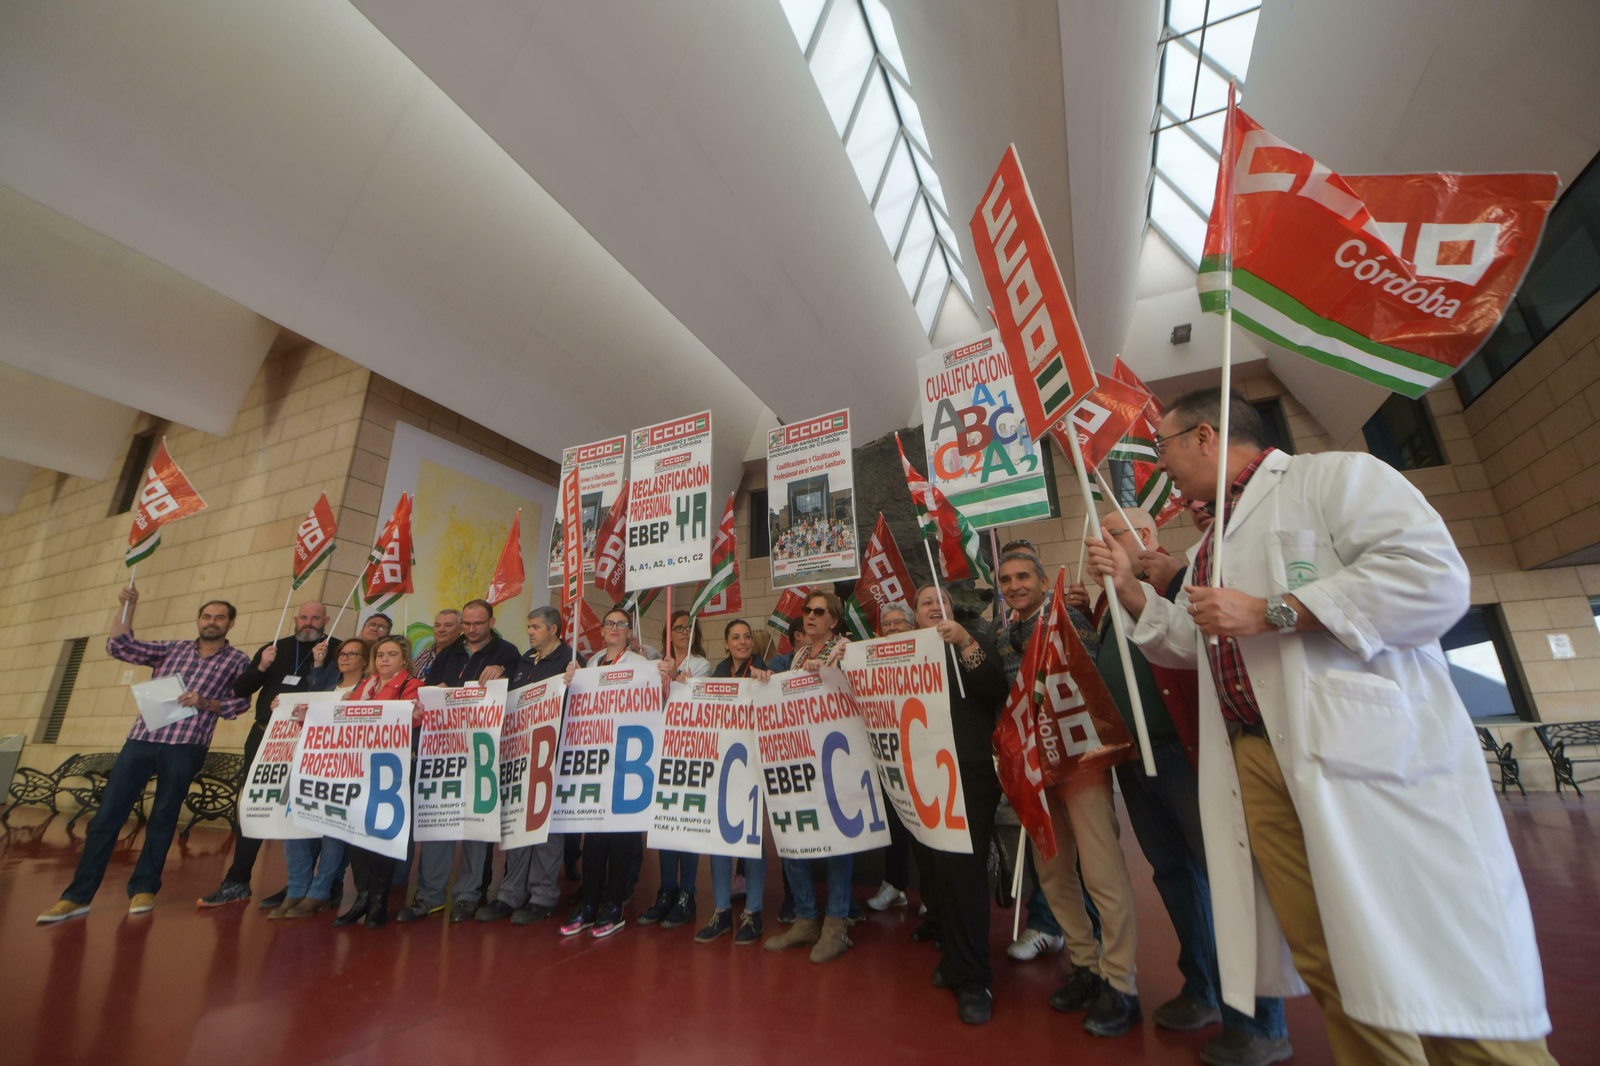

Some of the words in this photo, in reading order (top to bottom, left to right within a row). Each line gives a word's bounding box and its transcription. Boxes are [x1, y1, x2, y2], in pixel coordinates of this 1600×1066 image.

[981, 174, 1058, 373] CCOO
[1334, 239, 1462, 320] Córdoba
[956, 343, 984, 358] CCOO
[926, 351, 1013, 403] CUALIFICACION
[653, 420, 695, 442] CCOO
[789, 418, 832, 440] CCOO
[799, 437, 819, 447] sanidad
[816, 436, 840, 447] Córdoba
[580, 444, 613, 460] CCOO
[663, 439, 683, 448] sanidad
[679, 439, 702, 449] Córdoba
[773, 469, 798, 481] Profesional
[810, 463, 824, 472] Sector
[824, 459, 846, 470] Sanitario
[776, 457, 808, 471] Cualificaciones
[812, 450, 841, 462] Clasificación
[141, 466, 180, 521] OO
[631, 461, 709, 501] RECLASIFICACIÓN
[629, 493, 672, 523] PROFESIONAL
[675, 491, 707, 542] YA
[298, 509, 326, 553] OO
[566, 474, 578, 575] CCOO
[629, 521, 669, 548] EBEP
[692, 553, 703, 561] C2
[608, 672, 628, 680] CCOO
[708, 685, 731, 694] CCOO
[791, 677, 814, 688] CCOO
[455, 689, 478, 698] CCOO
[568, 681, 660, 718] RECLASIFICACIÓN
[347, 707, 374, 716] CCOO
[422, 699, 504, 732] RECLASIFICACIÓN
[501, 692, 562, 738] RECLASIFICACIÓN
[665, 699, 755, 731] RECLASIFICACIÓ
[756, 687, 861, 732] RECLASIFICACIÓN
[303, 718, 410, 750] RECLASIFICACIÓN
[421, 731, 469, 756] PROFESIONAL
[564, 718, 614, 746] PROFESIONAL
[661, 730, 719, 760] PROFESIONAL
[758, 729, 816, 763] PROFESIONAL
[1038, 708, 1060, 764] doba
[867, 733, 900, 762] BEP
[252, 763, 288, 784] EBEP
[299, 752, 365, 779] PROFESIONAL
[420, 756, 467, 779] EBEP
[473, 732, 498, 814] B
[500, 757, 527, 786] EBEP
[560, 749, 610, 776] EBEP
[611, 725, 655, 814] B
[658, 758, 714, 788] EBEP
[899, 697, 967, 830] C2
[299, 778, 362, 806] EBEP
[418, 780, 461, 801] YA
[525, 725, 557, 832] B
[763, 763, 816, 795] EBEP
[821, 731, 886, 838] C1
[248, 789, 281, 803] YA
[364, 752, 406, 841] B
[500, 783, 522, 807] YA
[556, 783, 601, 804] YA
[656, 791, 706, 813] YA
[717, 742, 761, 846] C1
[772, 809, 820, 833] YA
